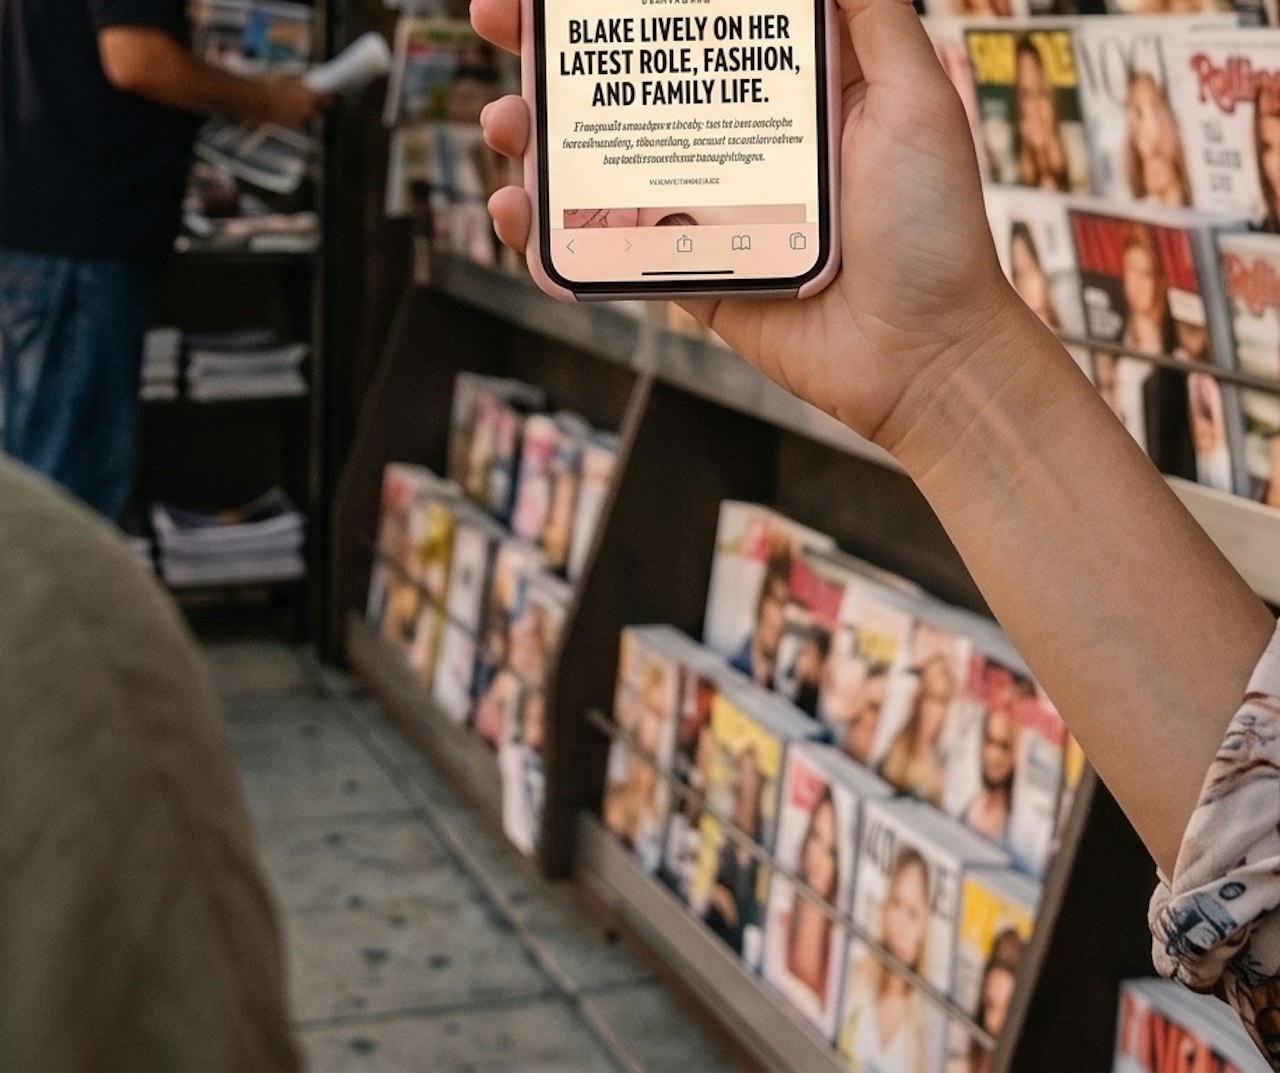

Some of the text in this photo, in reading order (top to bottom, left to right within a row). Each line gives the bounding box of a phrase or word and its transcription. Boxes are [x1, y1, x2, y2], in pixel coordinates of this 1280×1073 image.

[569, 14, 790, 44] BLAKE LIVELY ON HER
[560, 46, 801, 77] LATEST ROLE, FASHION,
[592, 78, 770, 107] AND FAMILY LIFE.
